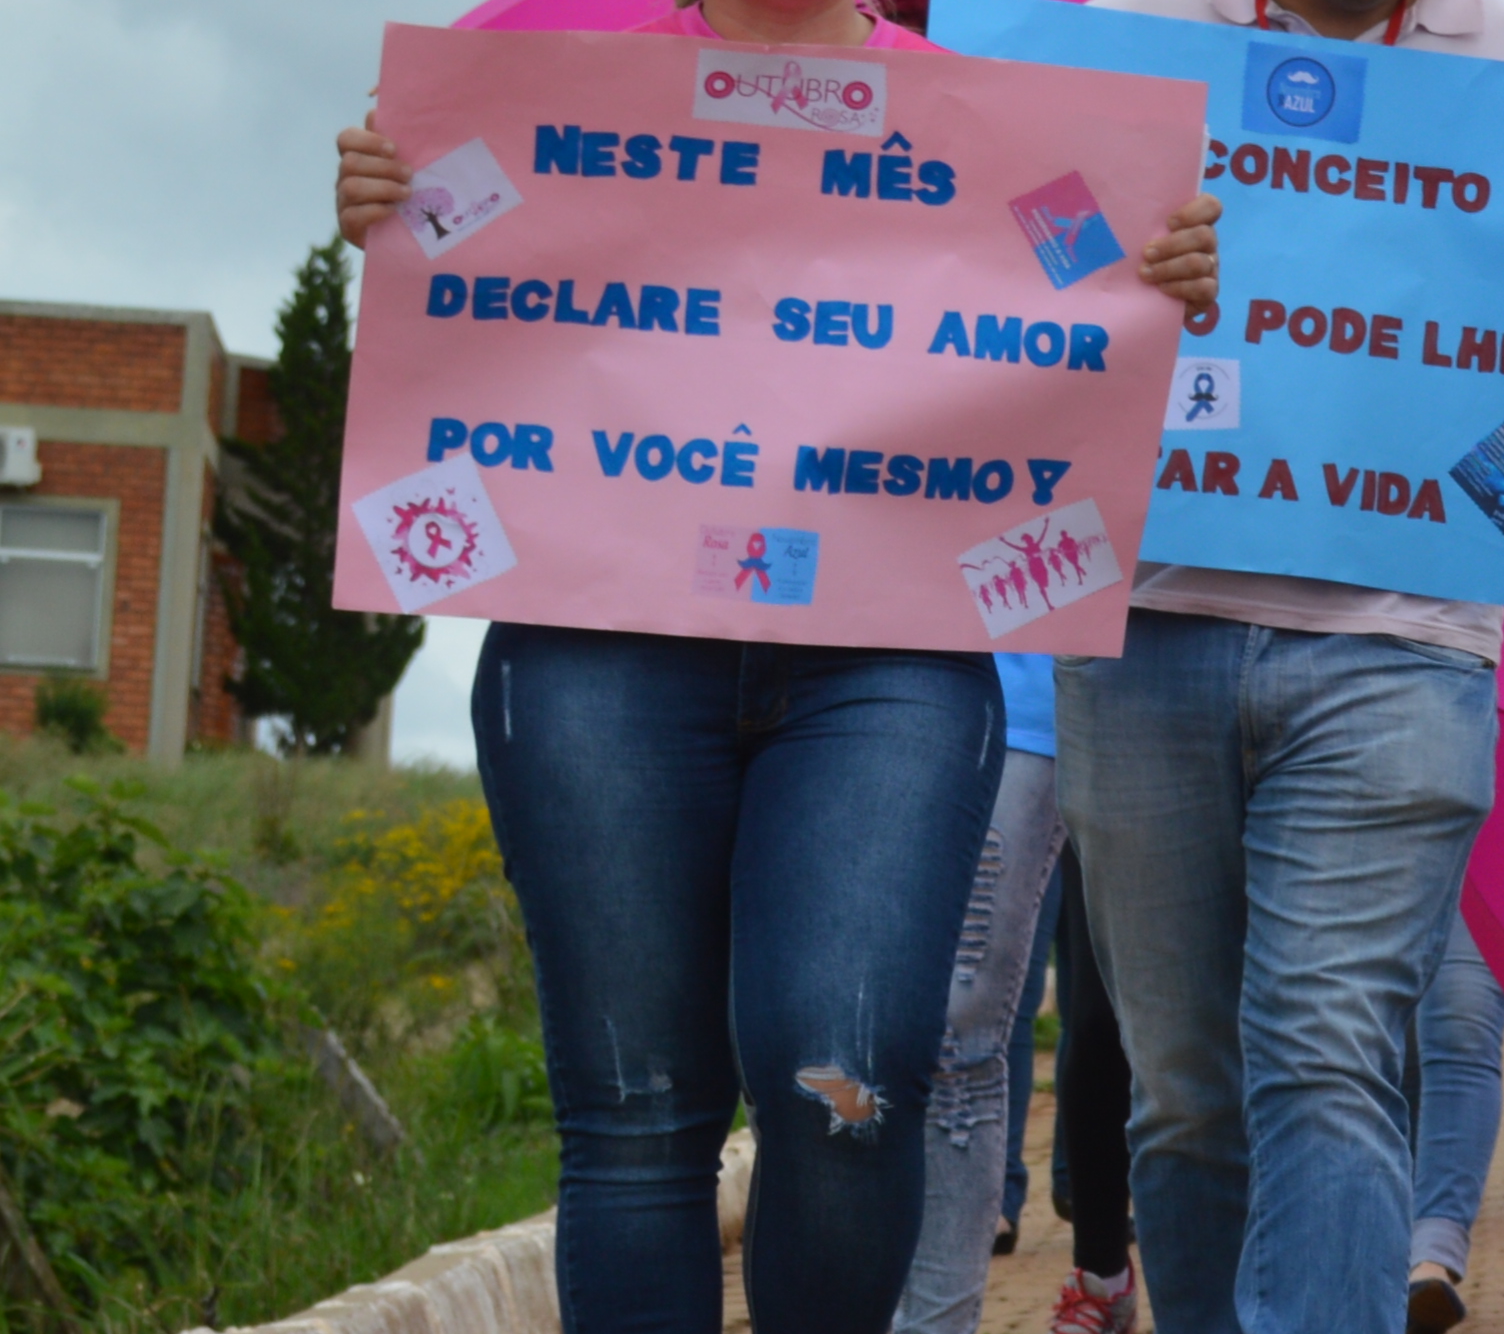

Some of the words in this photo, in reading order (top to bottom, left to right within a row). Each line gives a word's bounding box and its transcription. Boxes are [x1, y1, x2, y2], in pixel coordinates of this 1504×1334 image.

[704, 70, 873, 111] OUTUBRO
[1283, 94, 1315, 114] AZUL
[534, 125, 760, 186] NESTE
[821, 131, 956, 206] MÊS
[427, 274, 721, 336] DECLARE
[773, 297, 893, 349] SEU
[929, 311, 1109, 371] AMOR
[1245, 299, 1403, 359] PODE
[427, 417, 554, 472] POR
[592, 424, 759, 488] VOCÊ
[1258, 459, 1299, 501] A
[1321, 463, 1447, 524] VIDA
